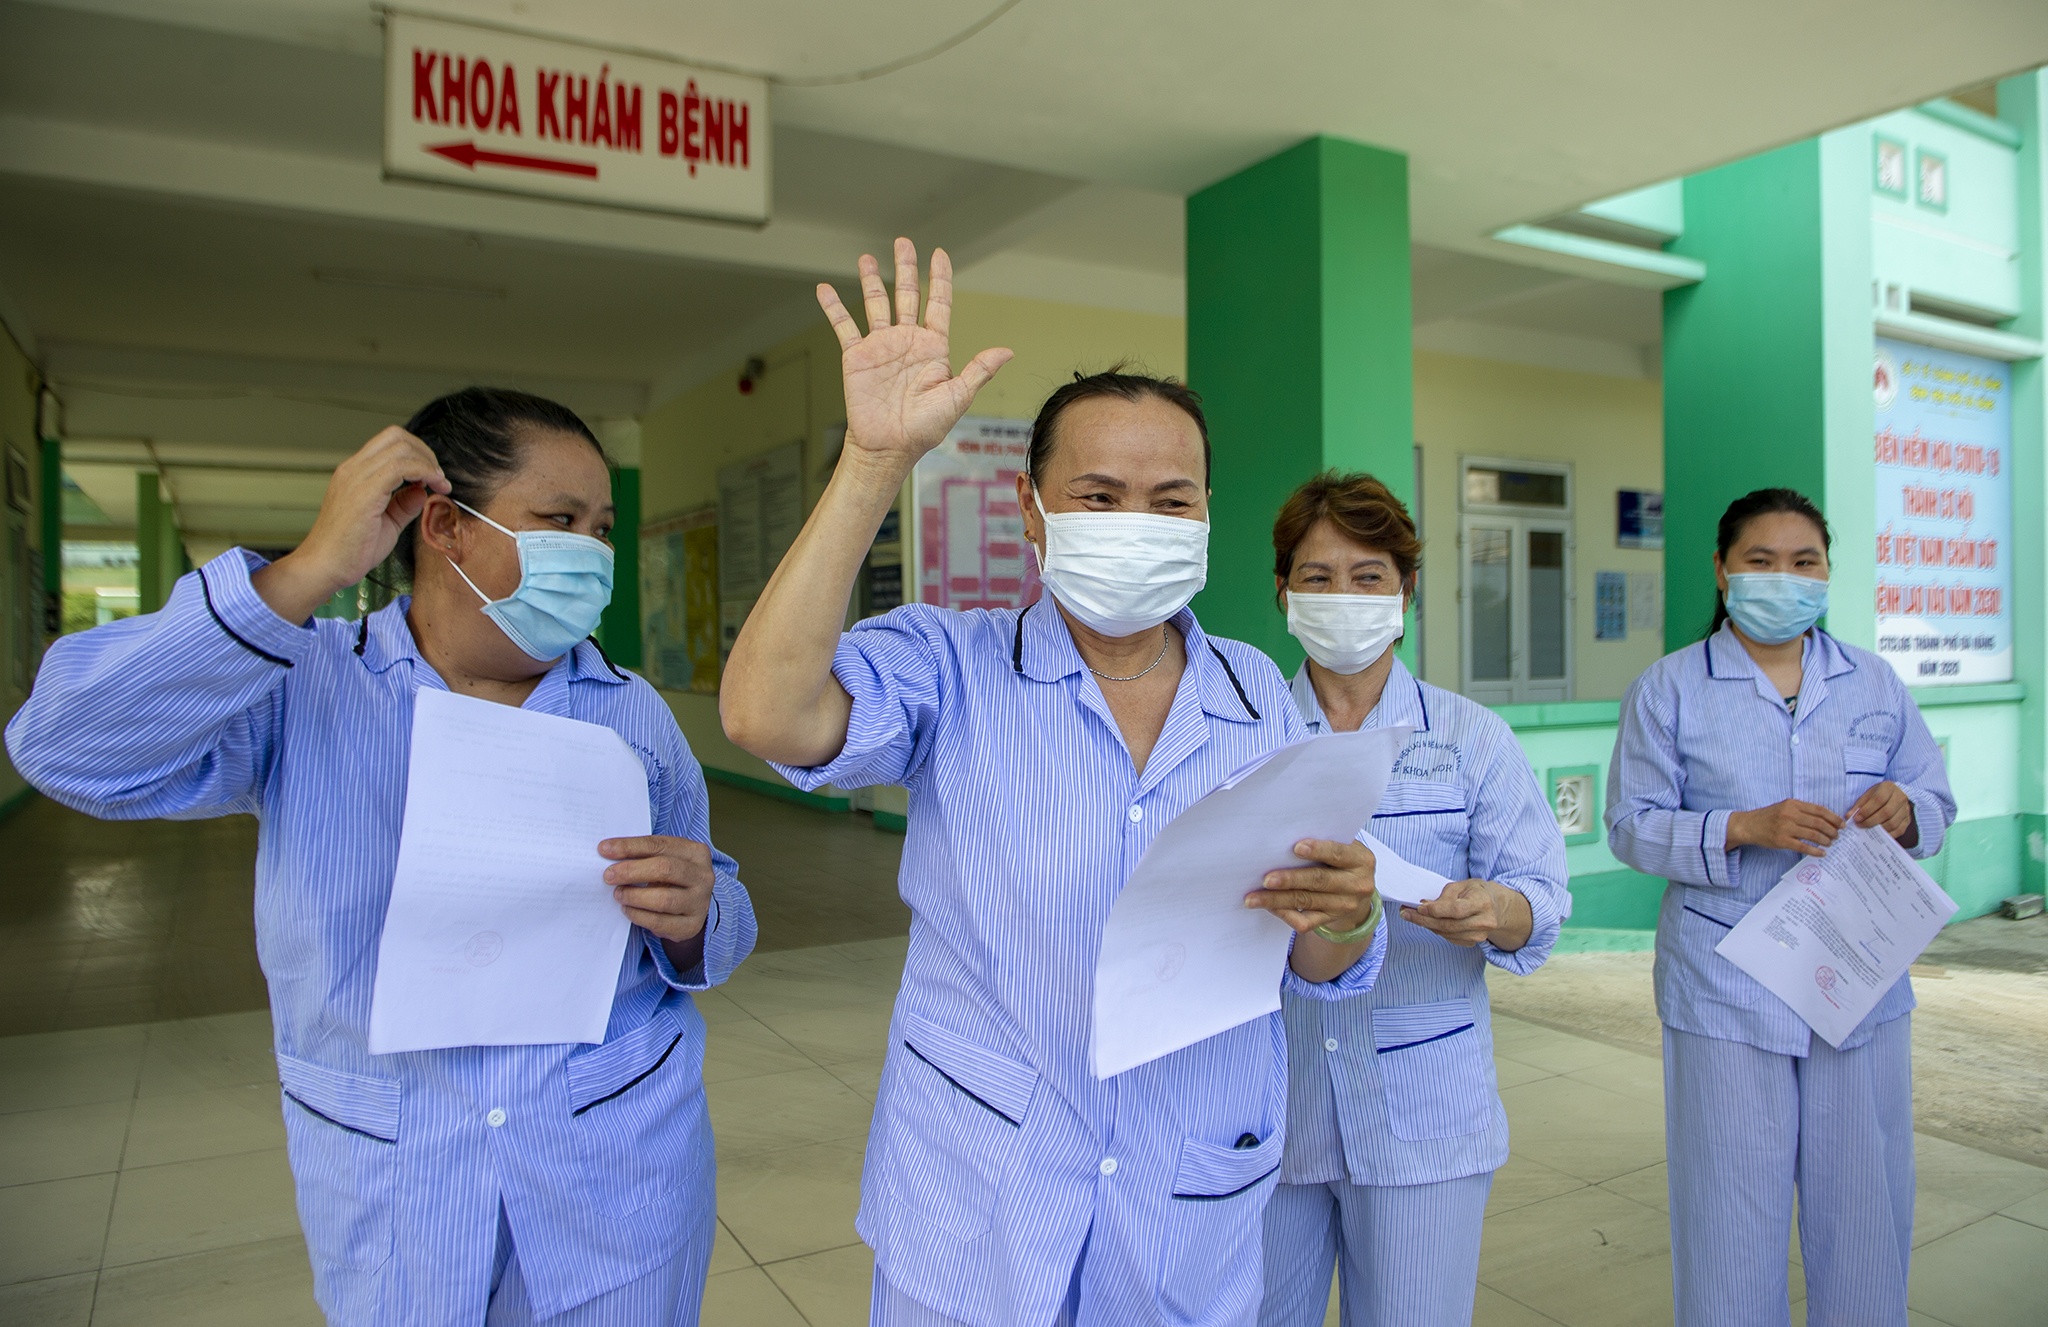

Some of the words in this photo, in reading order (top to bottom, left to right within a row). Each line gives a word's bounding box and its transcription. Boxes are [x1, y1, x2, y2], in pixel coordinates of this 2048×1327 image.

[413, 49, 522, 137] KHOA
[537, 61, 642, 153] KHÁM
[659, 77, 750, 178] BỆNH
[1403, 765, 1428, 777] KHOA
